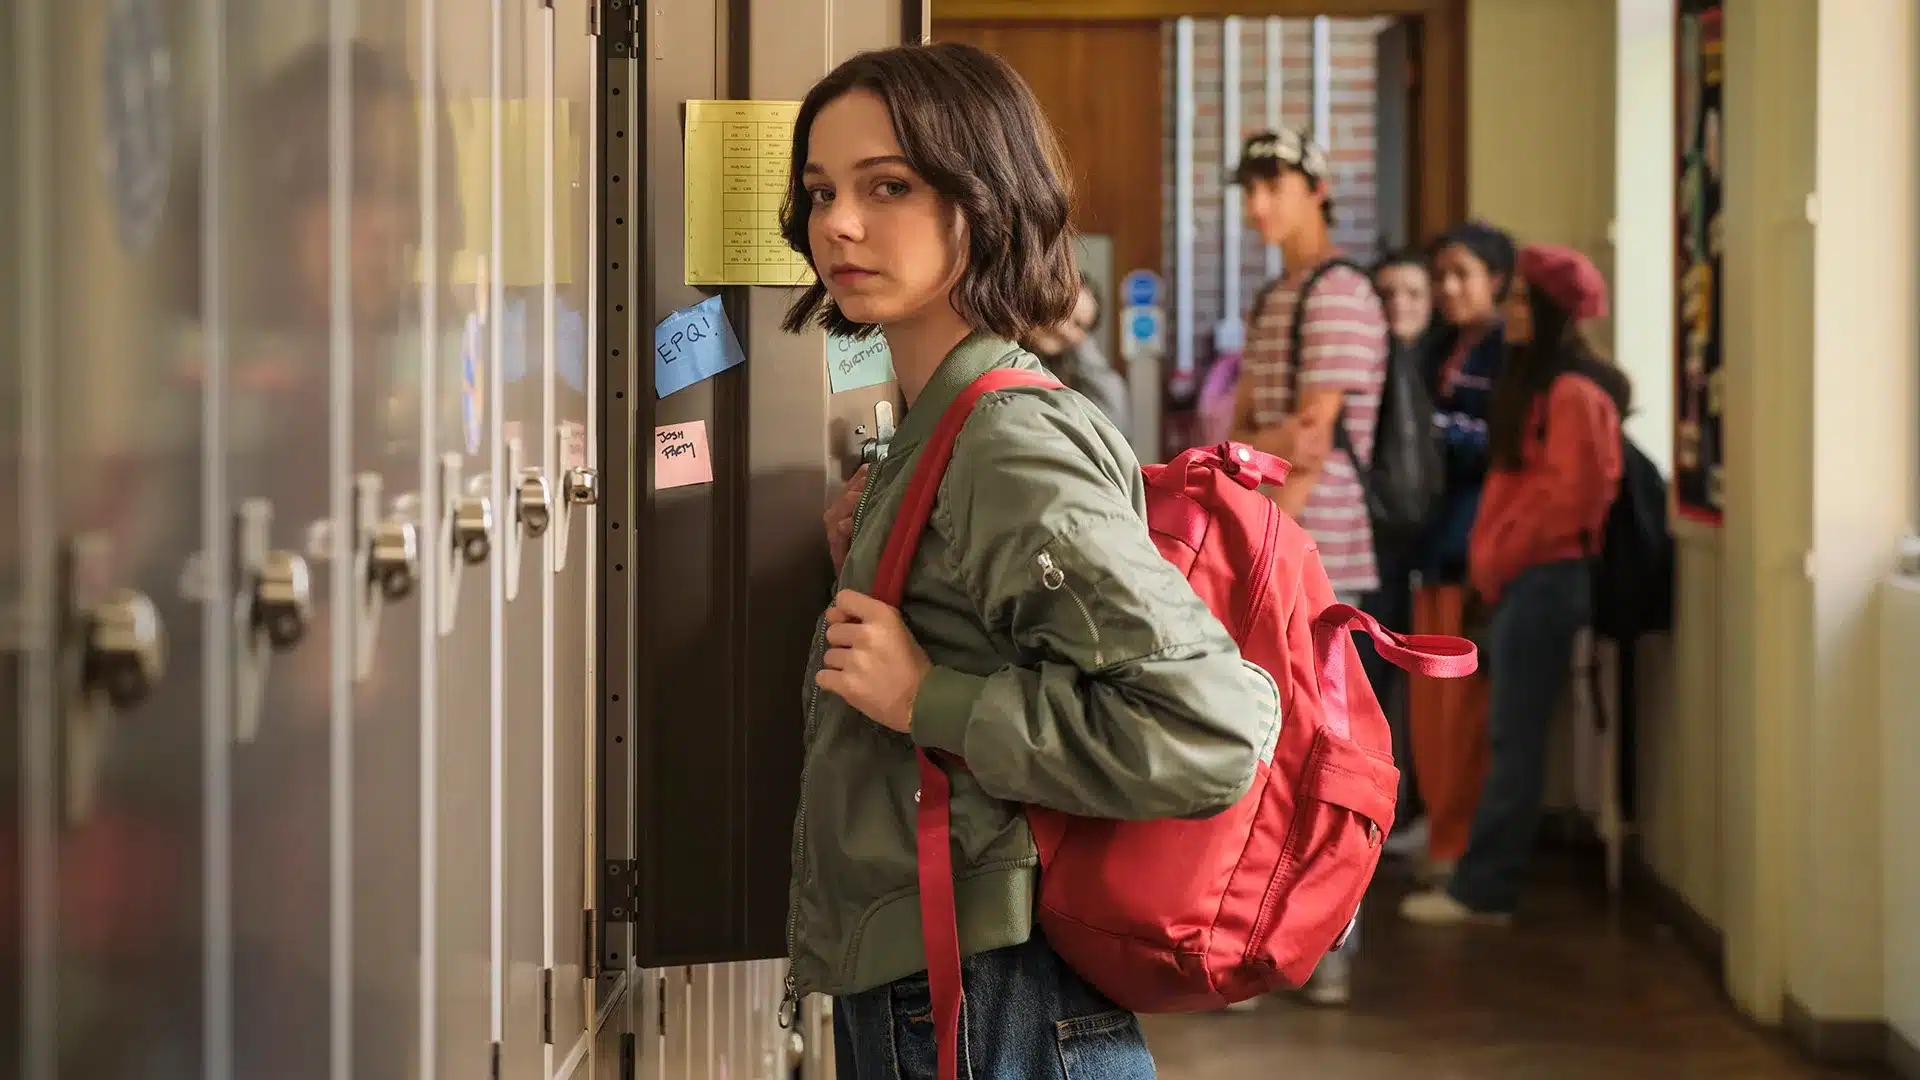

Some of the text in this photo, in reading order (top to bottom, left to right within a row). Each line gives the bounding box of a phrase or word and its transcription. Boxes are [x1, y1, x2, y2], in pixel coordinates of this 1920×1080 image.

[657, 316, 719, 364] EPQ!
[657, 430, 684, 444] JOSH
[661, 441, 696, 459] PARTY
